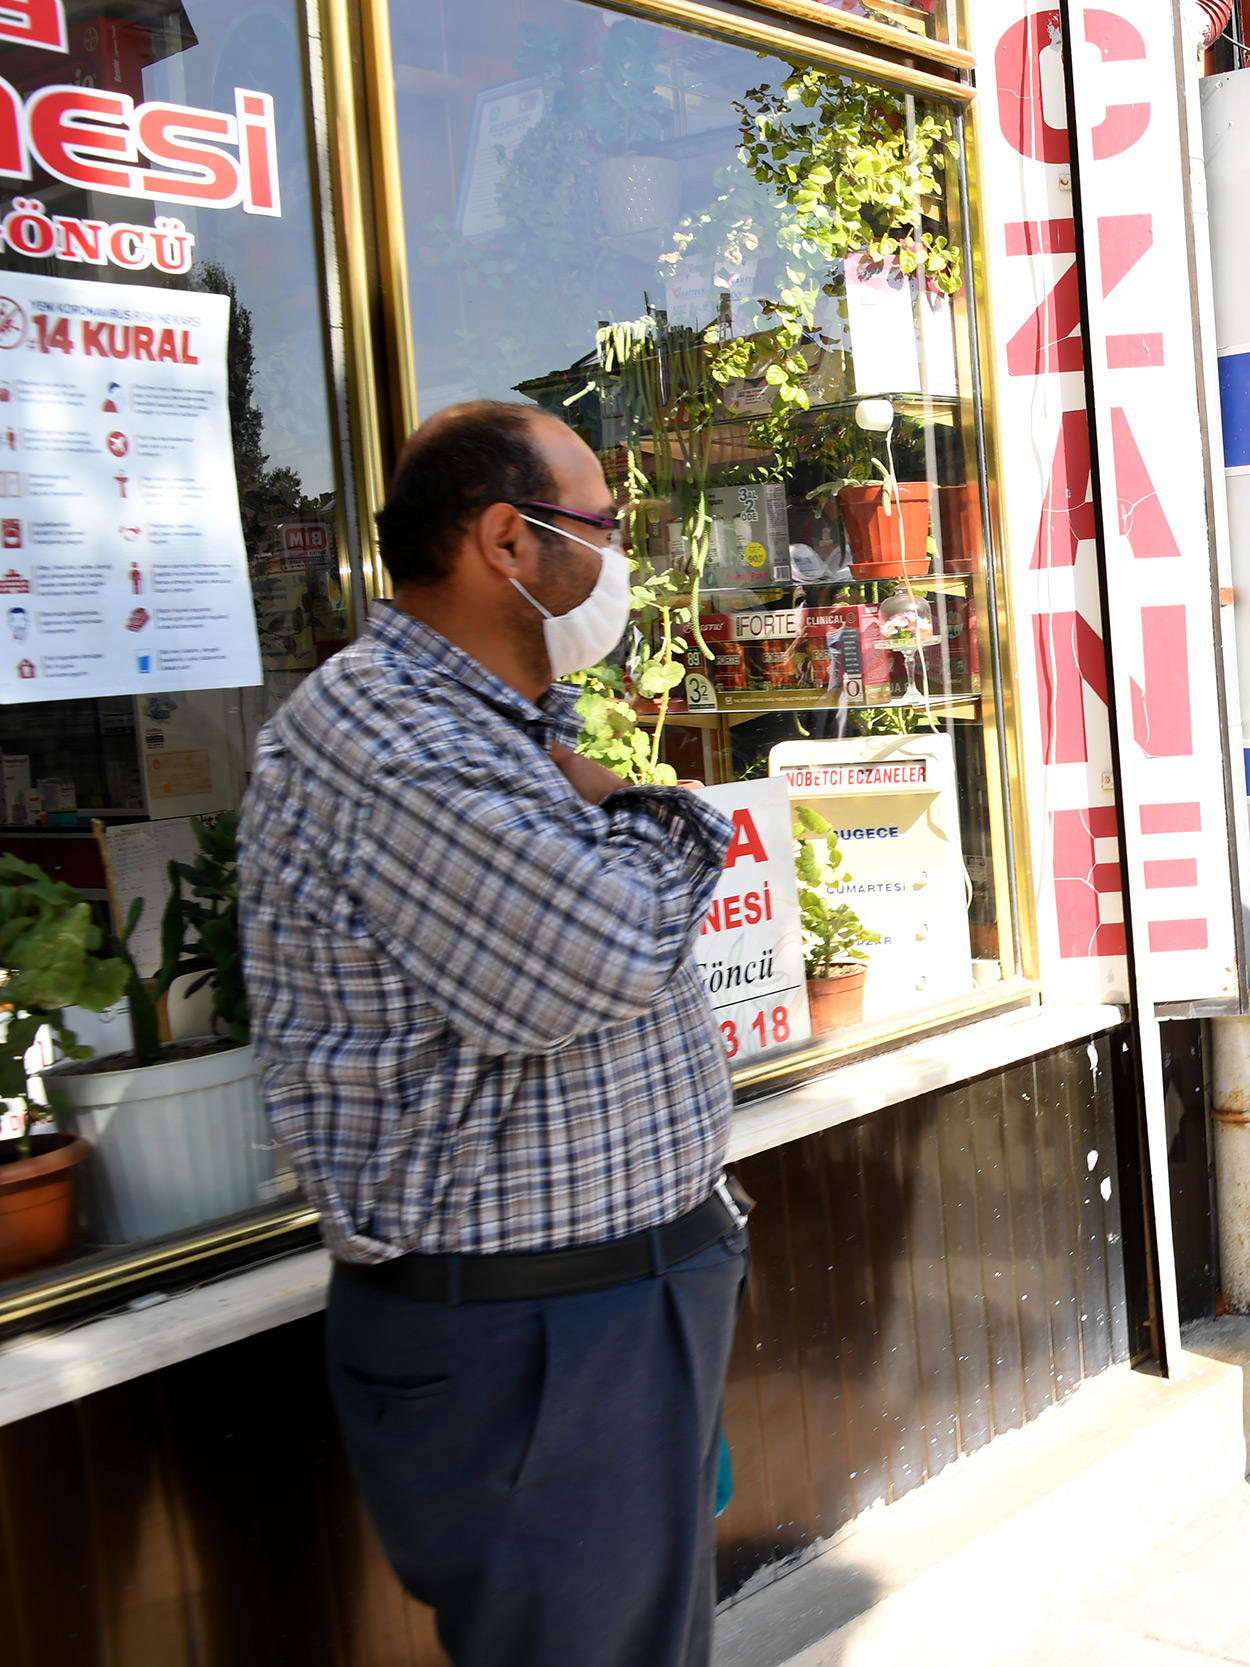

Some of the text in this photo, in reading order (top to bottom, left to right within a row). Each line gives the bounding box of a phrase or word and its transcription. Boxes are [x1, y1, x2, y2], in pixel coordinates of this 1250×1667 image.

[0, 197, 194, 275] ÖNCÜ
[82, 320, 199, 365] KURAL
[740, 613, 796, 637] FORTE
[806, 614, 844, 626] CLINICAL
[847, 764, 926, 785] ECZANELER
[752, 1006, 790, 1048] 18
